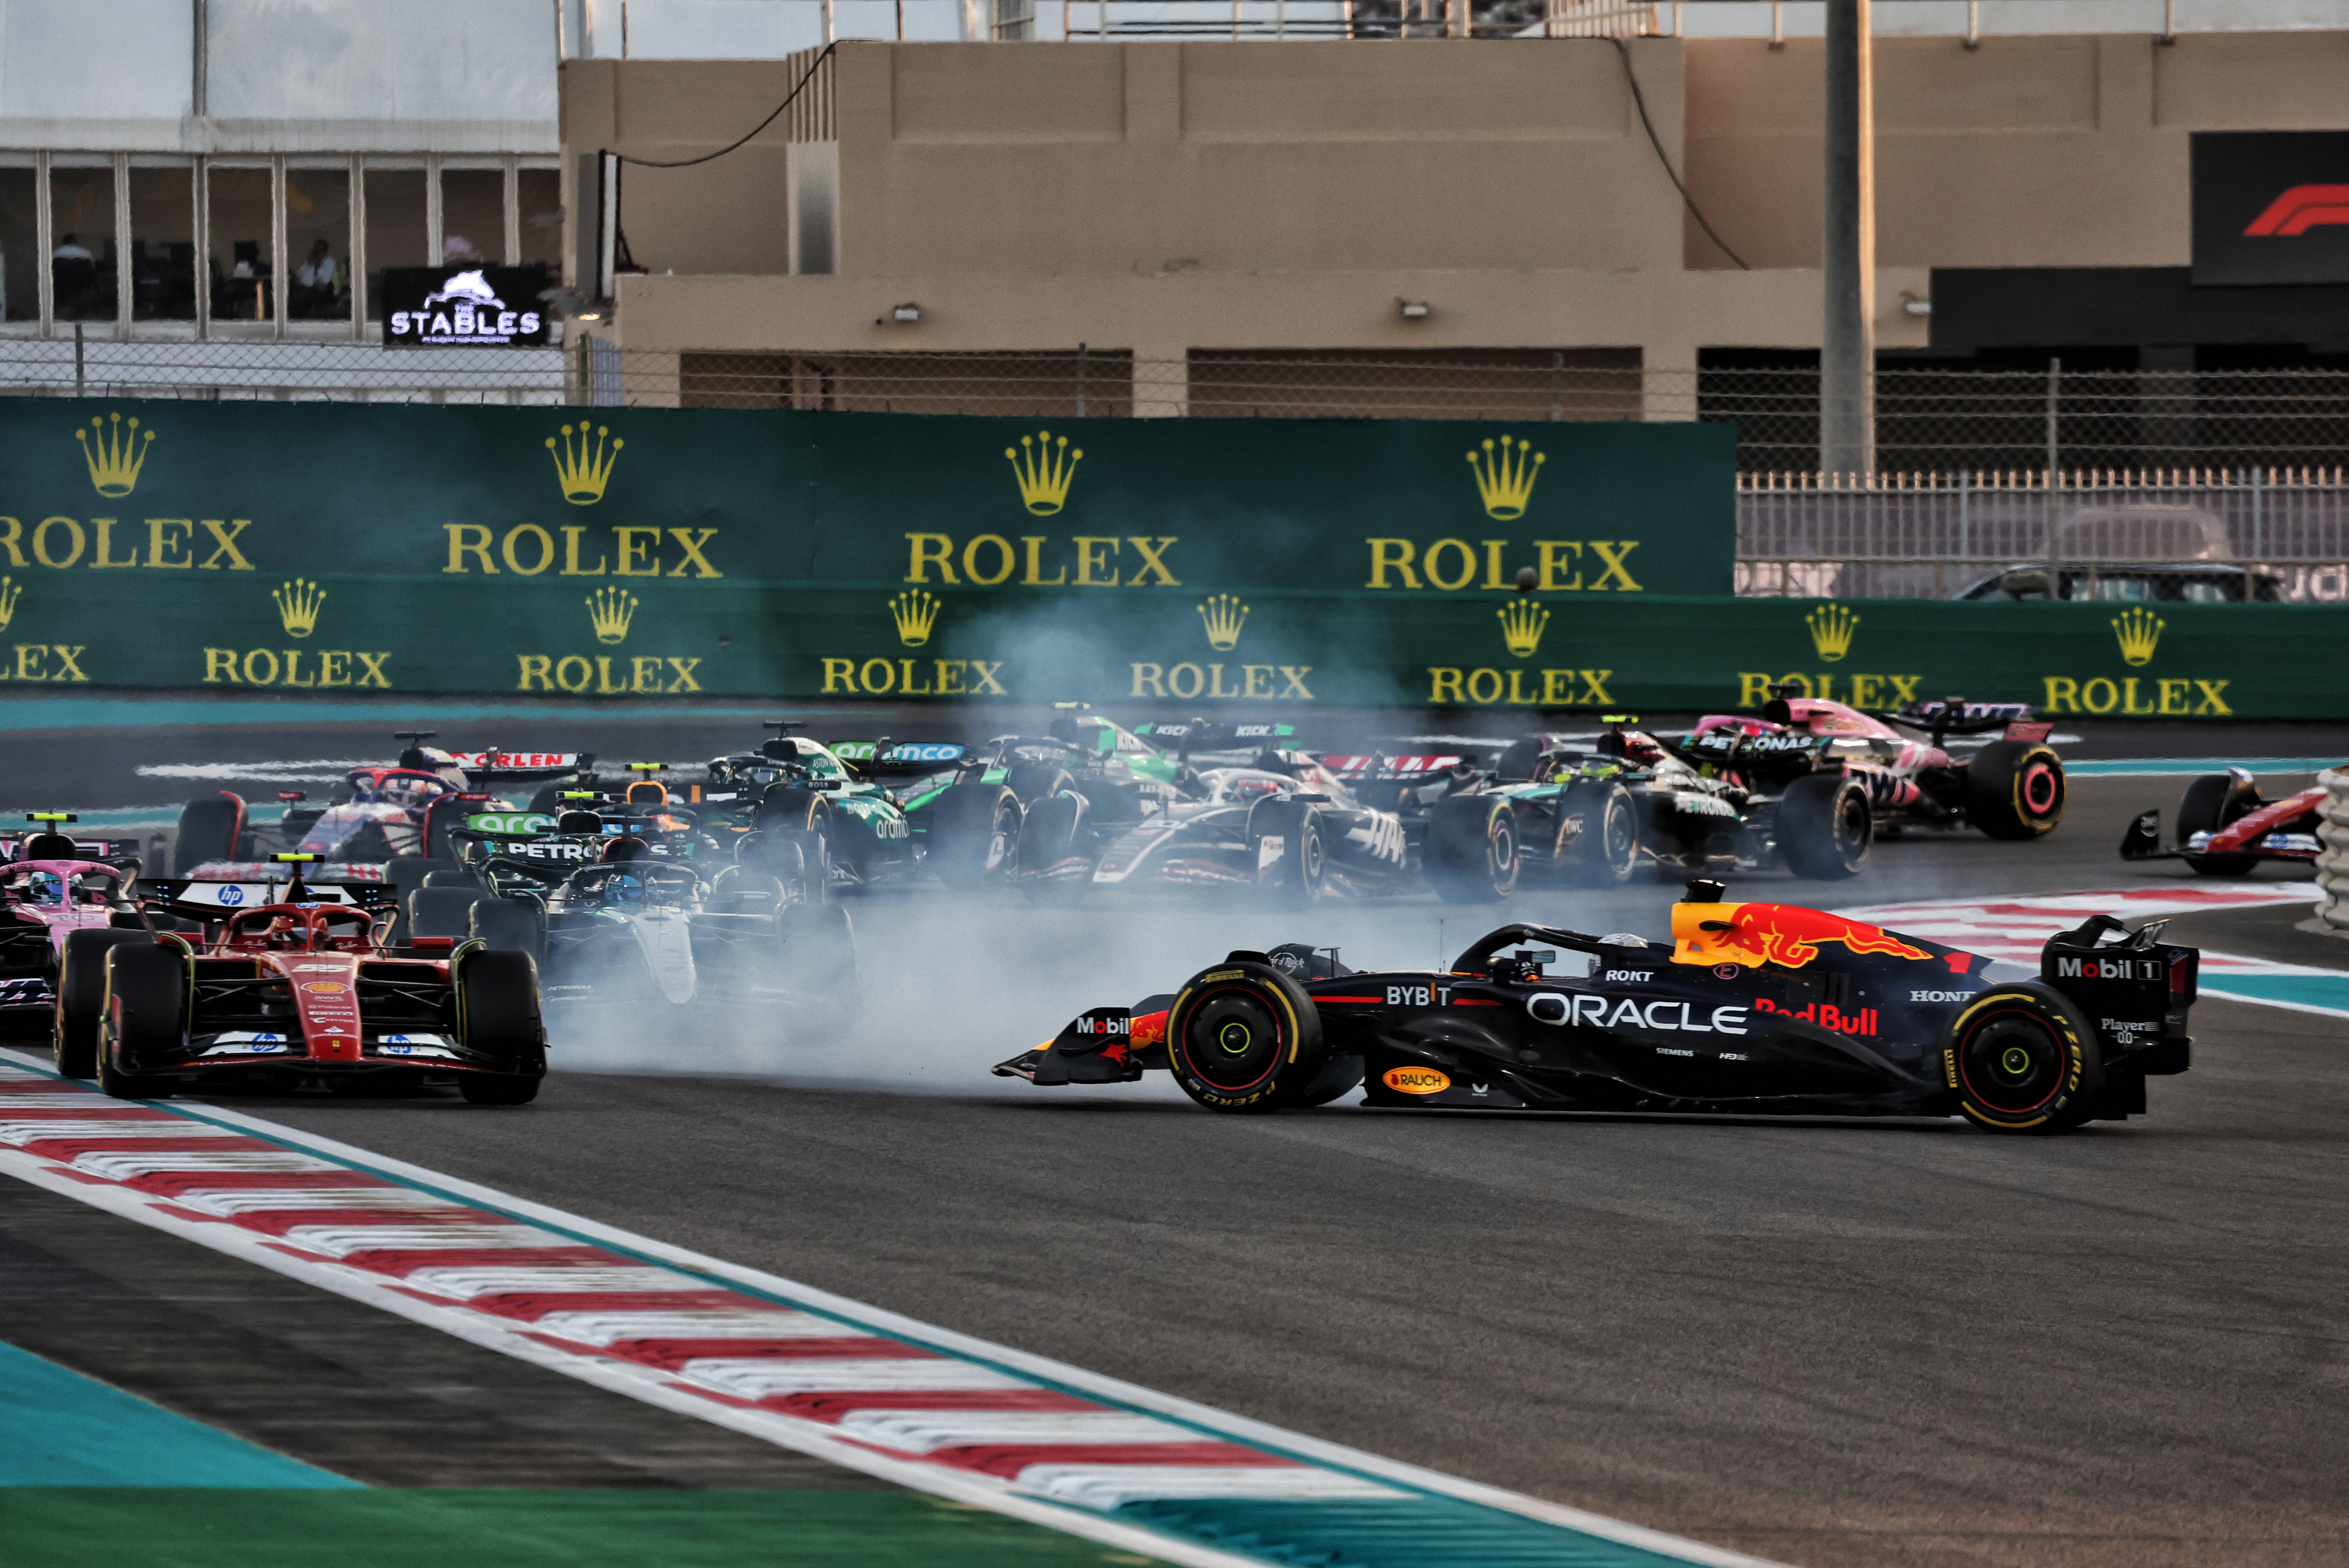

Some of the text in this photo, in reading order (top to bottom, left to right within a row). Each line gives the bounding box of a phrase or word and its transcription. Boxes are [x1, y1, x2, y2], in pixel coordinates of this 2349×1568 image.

[391, 311, 540, 335] STABLES
[442, 523, 723, 579] ROLEX
[903, 532, 1182, 587] ROLEX
[1365, 538, 1643, 591] ROLEX
[0, 644, 88, 681] EX
[203, 648, 392, 688] ROLEX
[517, 655, 702, 694] ROLEX
[821, 658, 1007, 695] ROLEX
[1130, 663, 1315, 700] ROLEX
[1428, 667, 1616, 705] ROLEX
[2043, 676, 2233, 715] ROLEX
[508, 842, 669, 859] PETROS
[220, 885, 241, 905] hp
[1944, 952, 1973, 974] 1
[2058, 957, 2152, 979] Mobil 1
[1605, 970, 1654, 982] ROKT
[1386, 982, 1451, 1006] BYBIT
[1526, 992, 1750, 1035] ORACLE
[1755, 998, 1878, 1037] Rd Bull
[1076, 1017, 1129, 1034] Mobil
[2101, 1018, 2145, 1033] Player
[1656, 1047, 1694, 1057] SIEMENS
[1400, 1074, 1442, 1086] RAUCH
